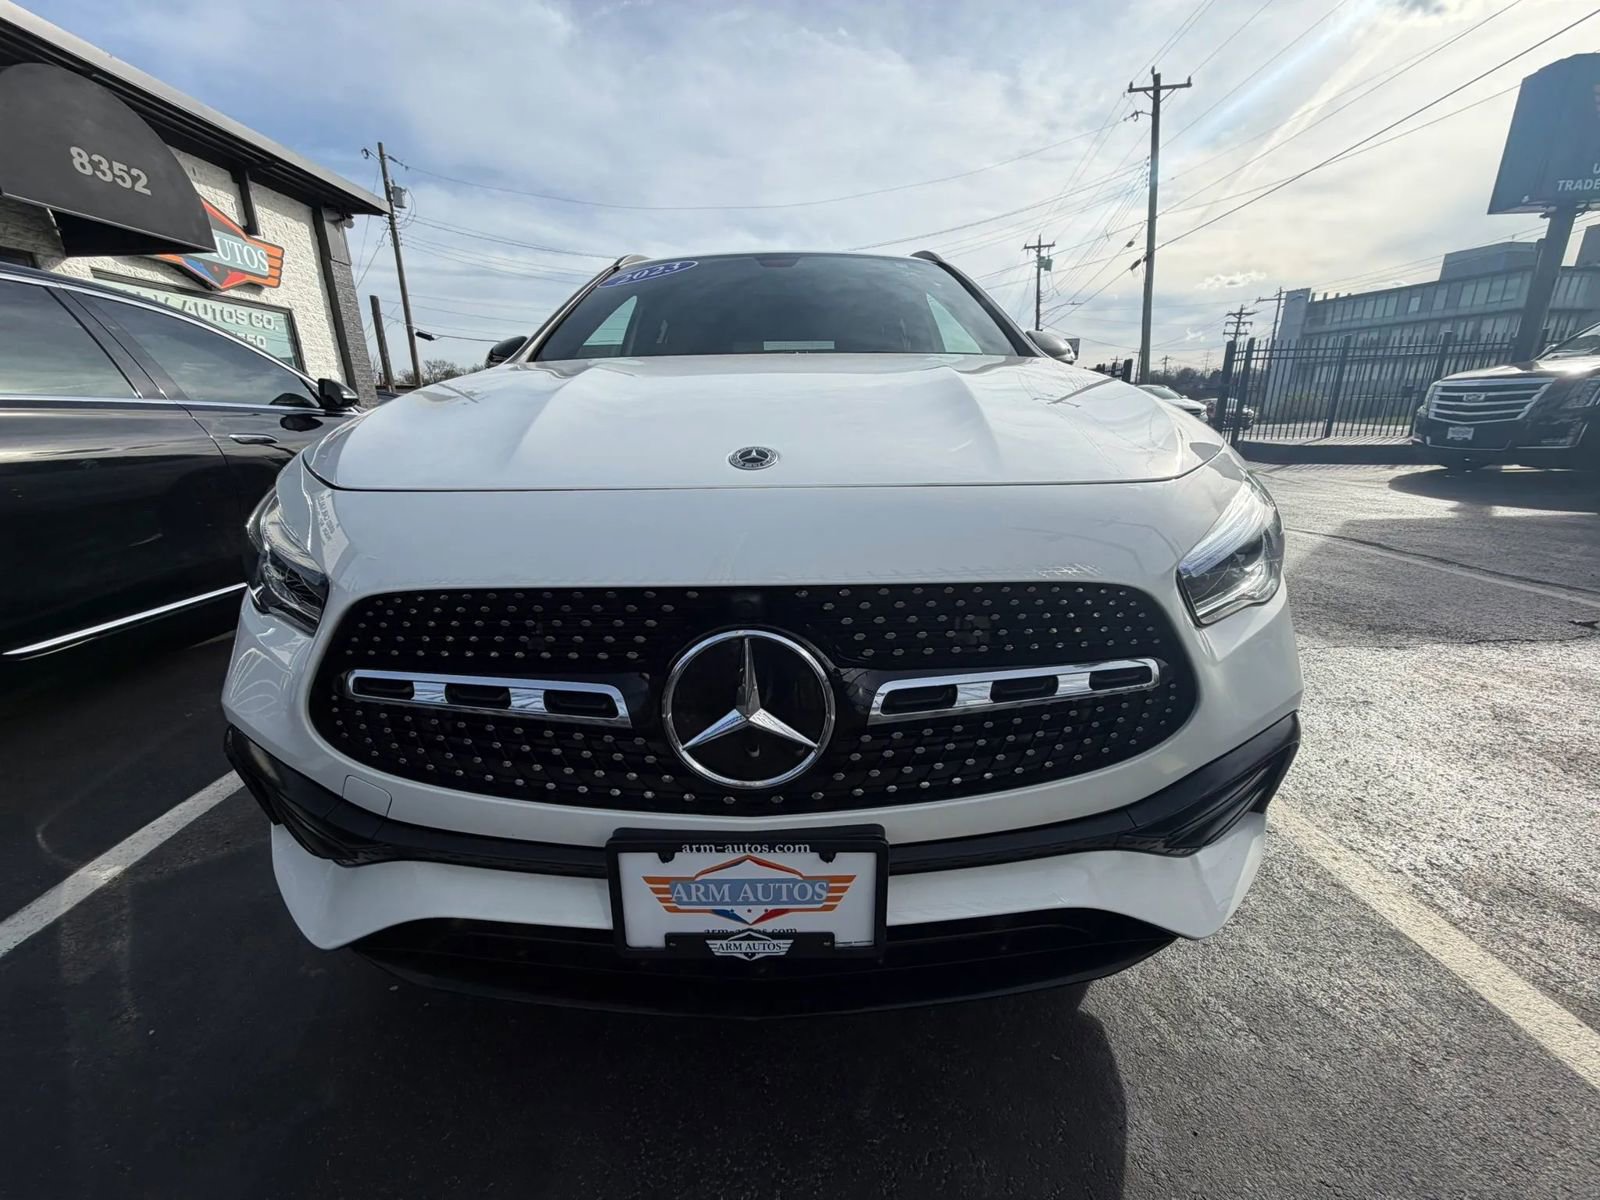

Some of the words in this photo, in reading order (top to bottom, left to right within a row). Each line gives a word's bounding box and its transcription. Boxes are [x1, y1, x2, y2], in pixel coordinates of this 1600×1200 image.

[70, 146, 152, 196] 8352
[212, 236, 269, 272] UTOS
[616, 262, 681, 285] 2023
[183, 299, 247, 326] AUTOS
[681, 843, 811, 854] arm-autos.com
[671, 883, 731, 902] ARM
[737, 882, 828, 902] AUTOS
[717, 943, 743, 952] ARM
[744, 943, 782, 952] AUTOS
